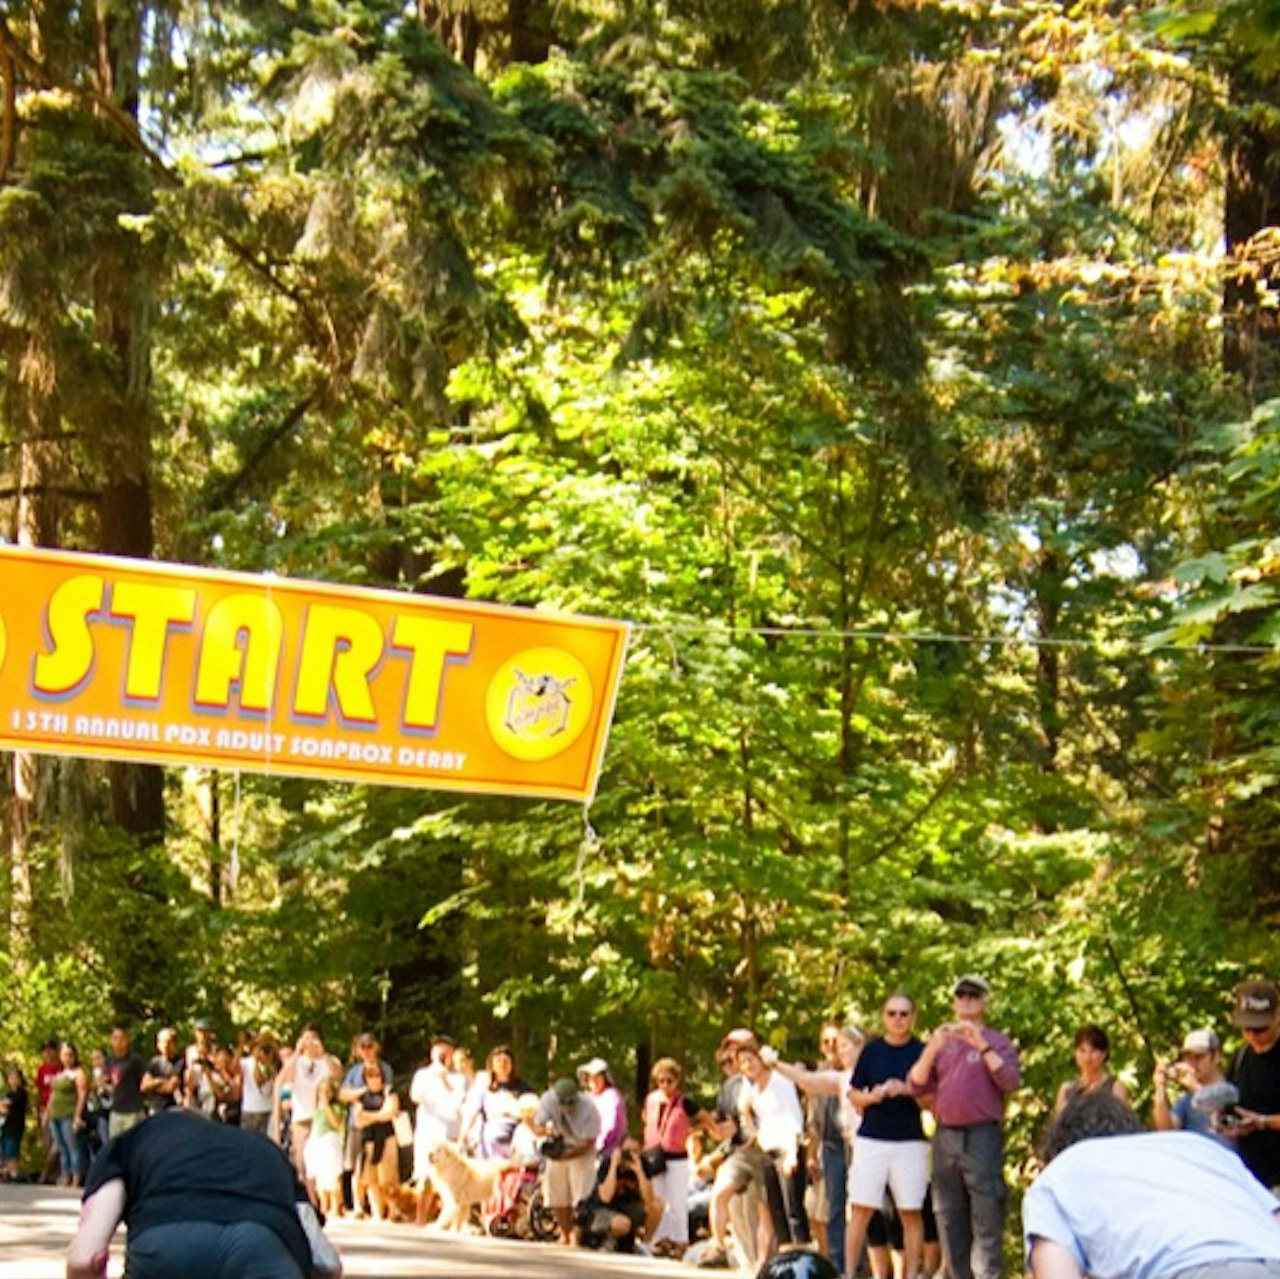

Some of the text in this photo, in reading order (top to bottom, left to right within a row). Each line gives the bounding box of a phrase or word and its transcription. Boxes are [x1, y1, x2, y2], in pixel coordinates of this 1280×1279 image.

[31, 574, 475, 736] START
[74, 715, 160, 743] ANNUAL
[164, 722, 211, 747] PDX
[216, 728, 285, 754] ADULT
[290, 737, 394, 765] SOAPBOX
[397, 750, 467, 771] DERBY
